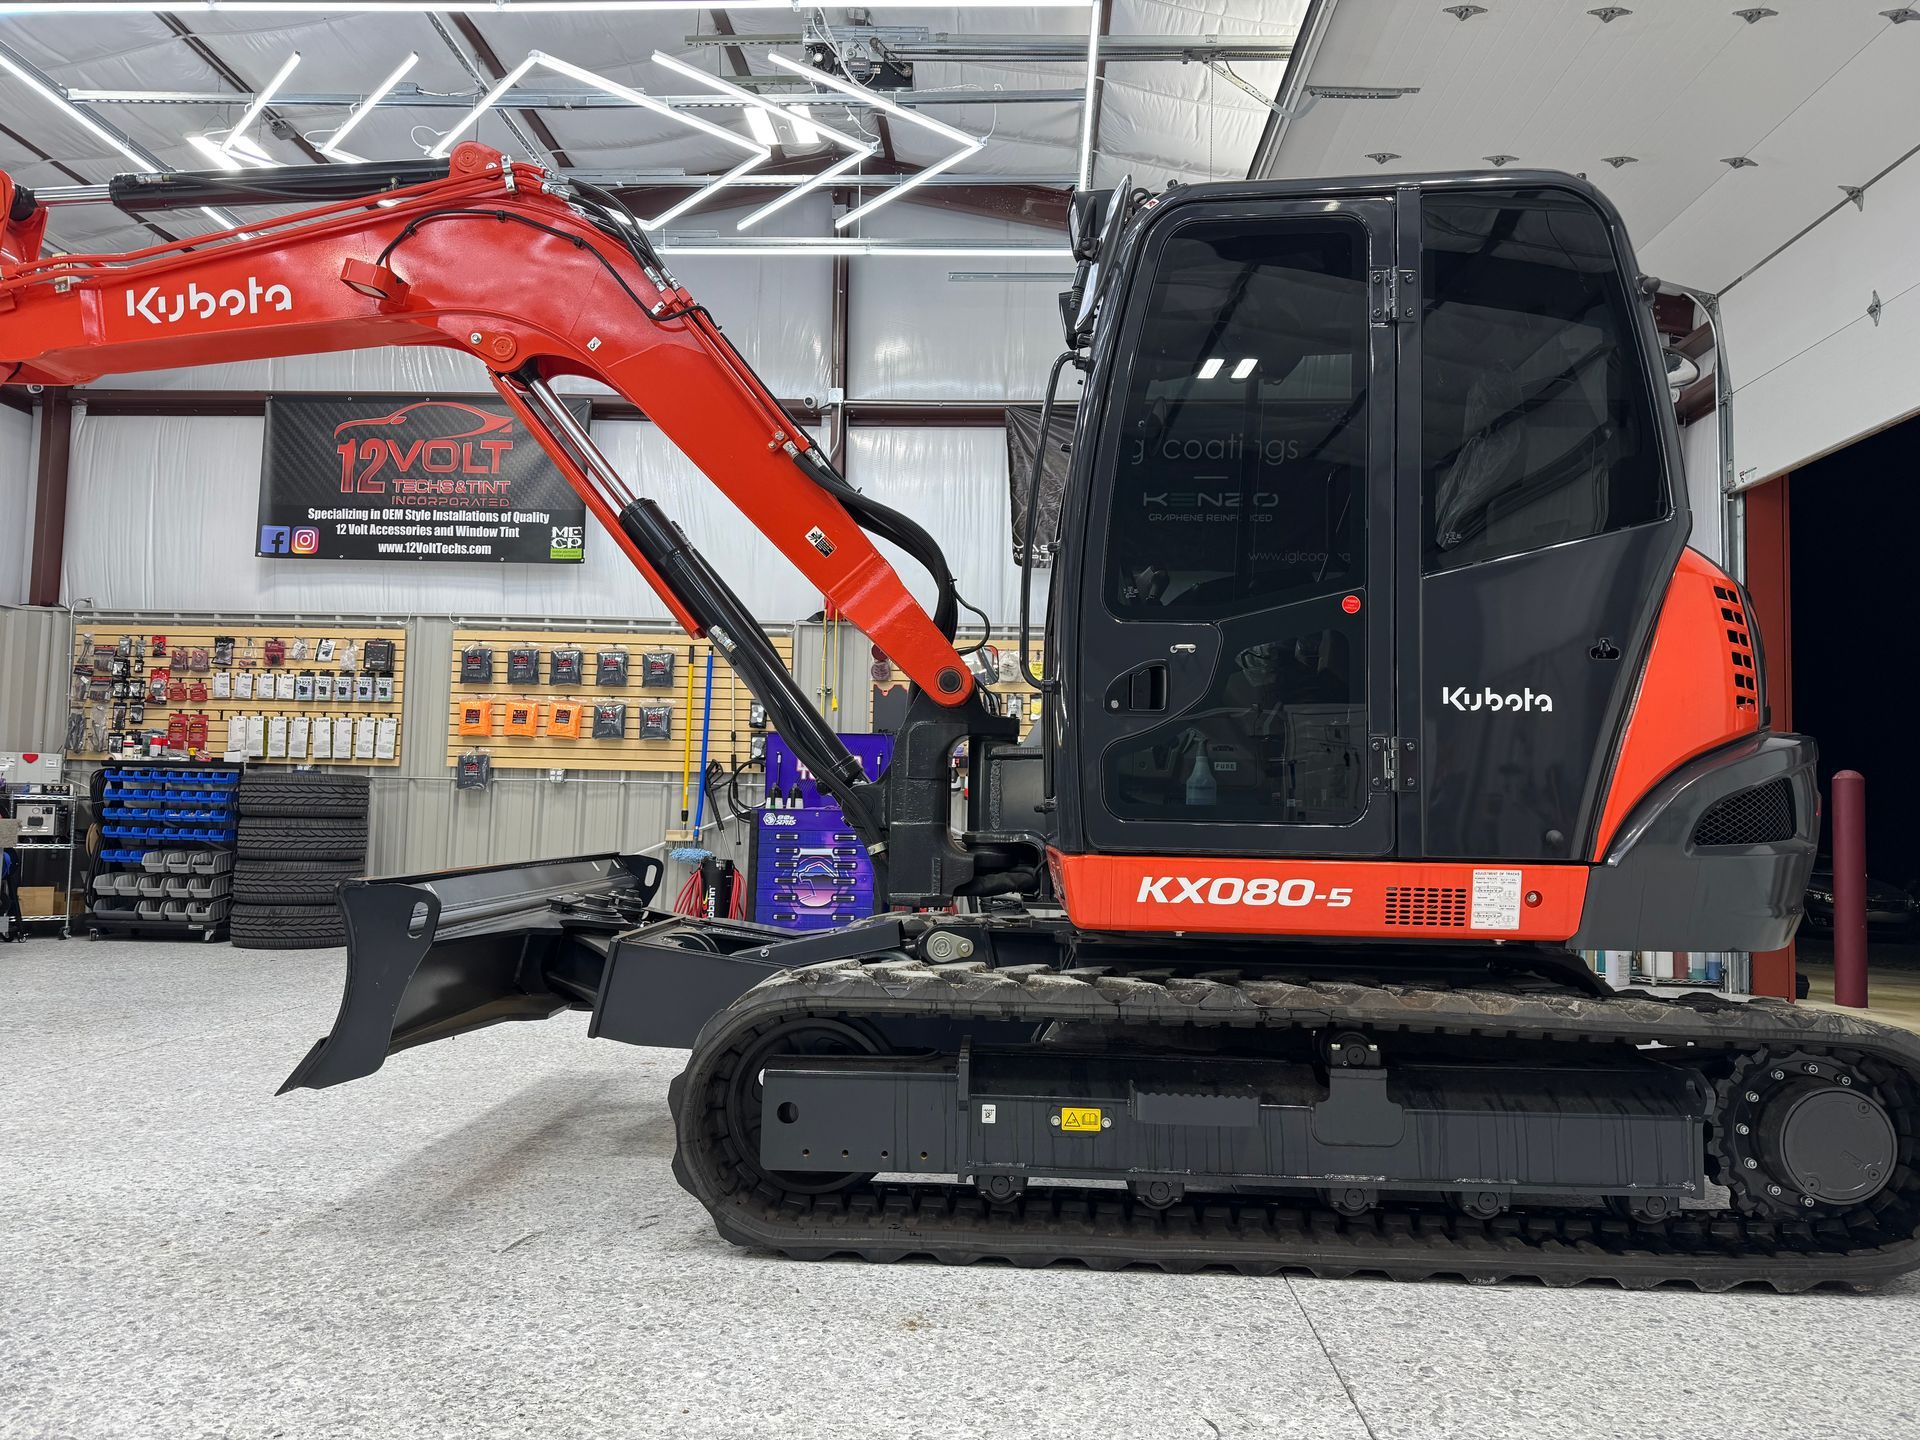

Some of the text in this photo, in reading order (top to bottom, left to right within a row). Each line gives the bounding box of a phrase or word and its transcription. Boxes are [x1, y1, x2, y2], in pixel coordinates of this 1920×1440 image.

[126, 276, 292, 324] Kubota
[391, 496, 511, 507] INCORPORATED
[308, 508, 550, 524] Specializing in OEM Style Installations of Quality
[1148, 513, 1273, 522] GRAPHENE REINFCED
[336, 524, 520, 538] 12 Volt Accessories and Window Tint
[378, 542, 492, 554] www.12VoltTechs.com
[1442, 686, 1553, 712] Kubota
[1136, 876, 1354, 907] KX080-5
